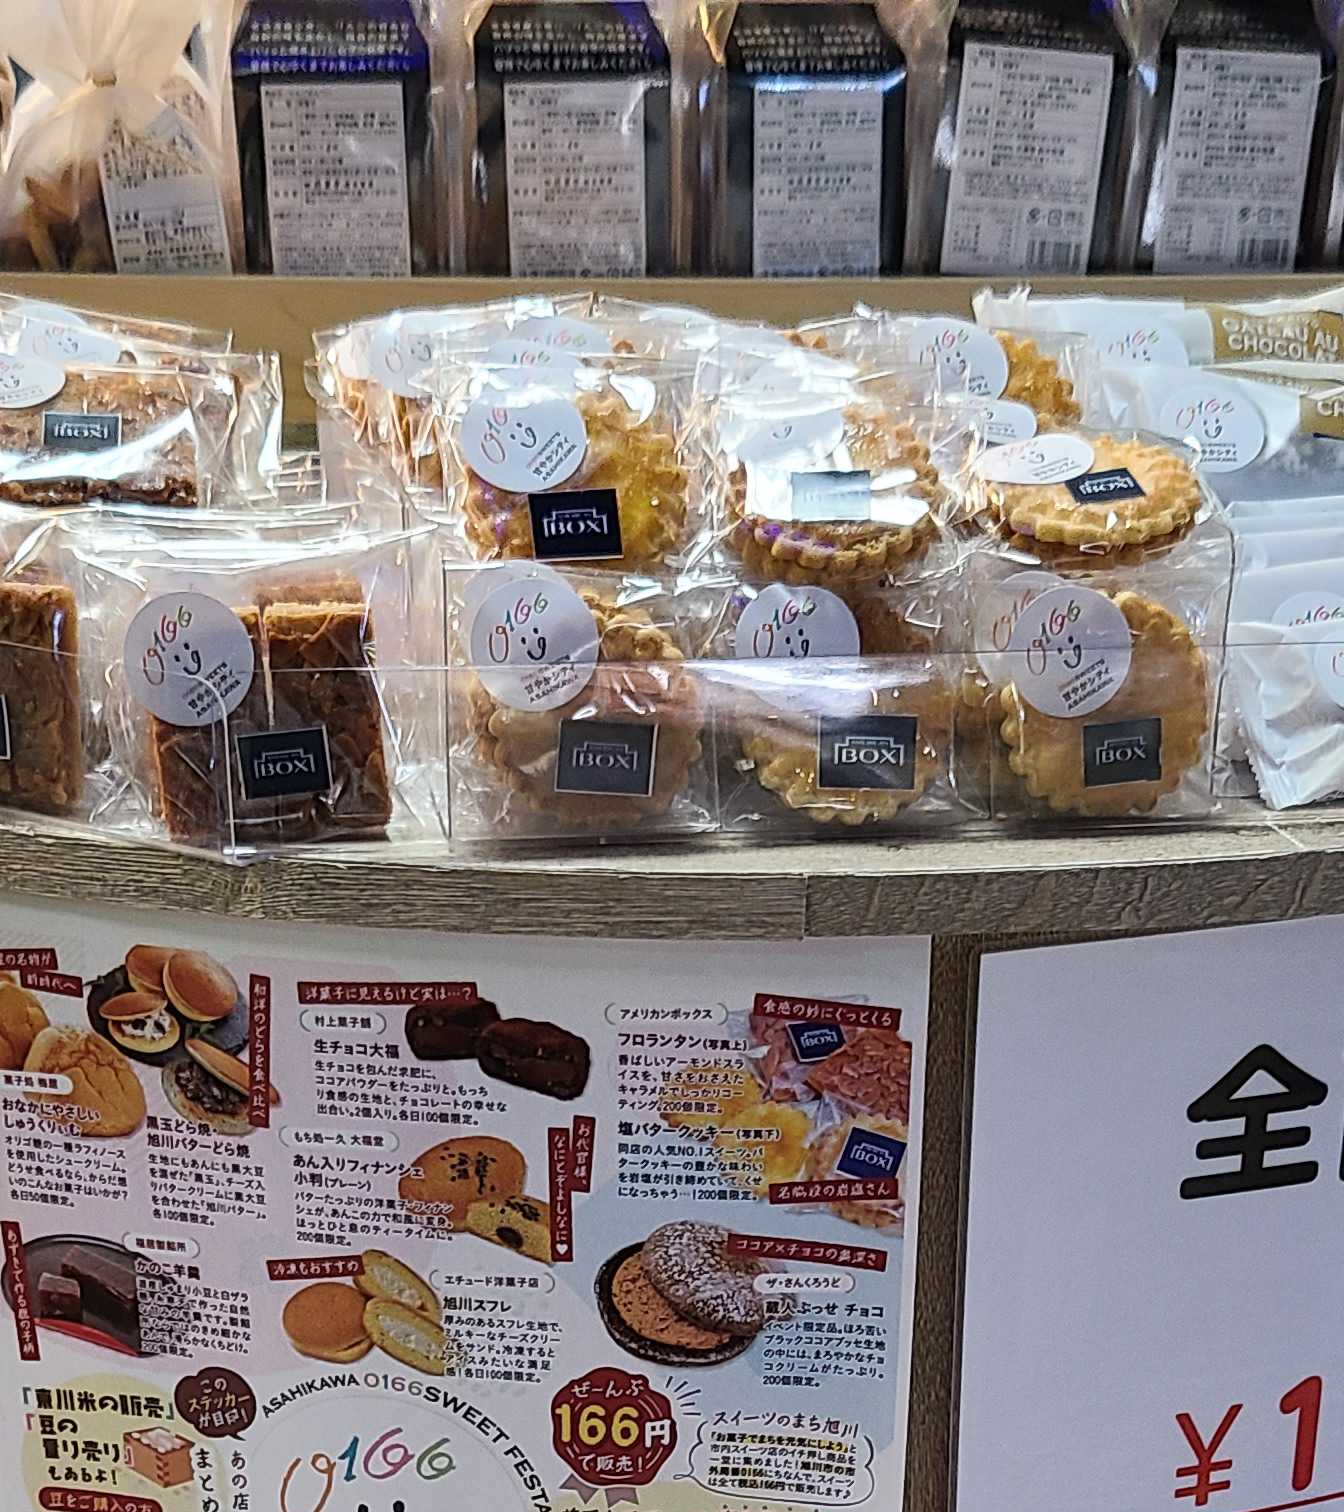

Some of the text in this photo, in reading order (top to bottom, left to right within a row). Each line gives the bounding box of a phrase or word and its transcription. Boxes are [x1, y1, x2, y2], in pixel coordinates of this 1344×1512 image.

[549, 517, 602, 535] BOX
[488, 592, 548, 663] 0166
[143, 605, 193, 685] 0166
[1027, 600, 1081, 677] 0166
[578, 752, 630, 768] BOX
[840, 746, 898, 764] BOX
[1101, 745, 1146, 764] BOX
[260, 757, 309, 777] BOX
[620, 1008, 712, 1021] アメリカンボックス
[314, 1039, 400, 1058] 生チョコ大福
[618, 1055, 745, 1069] 香ばしいアーモンドスラ
[2, 1098, 101, 1121] おなかにやさしい
[293, 1155, 424, 1179] あん入りフィナンシェ
[445, 1276, 539, 1289] エチュード洋菓子店
[443, 1296, 512, 1313] 旭川スフレ
[845, 1305, 883, 1318] チョコ
[201, 1378, 226, 1391] この
[189, 1393, 250, 1413] ステッカー
[262, 1373, 360, 1418] ASAHIKAWA
[364, 1372, 423, 1395] 0166
[424, 1384, 510, 1444] SWEET
[556, 1403, 672, 1448] 166円
[712, 1410, 857, 1438] スイーツのまち旭川
[578, 1454, 643, 1474] で販売!
